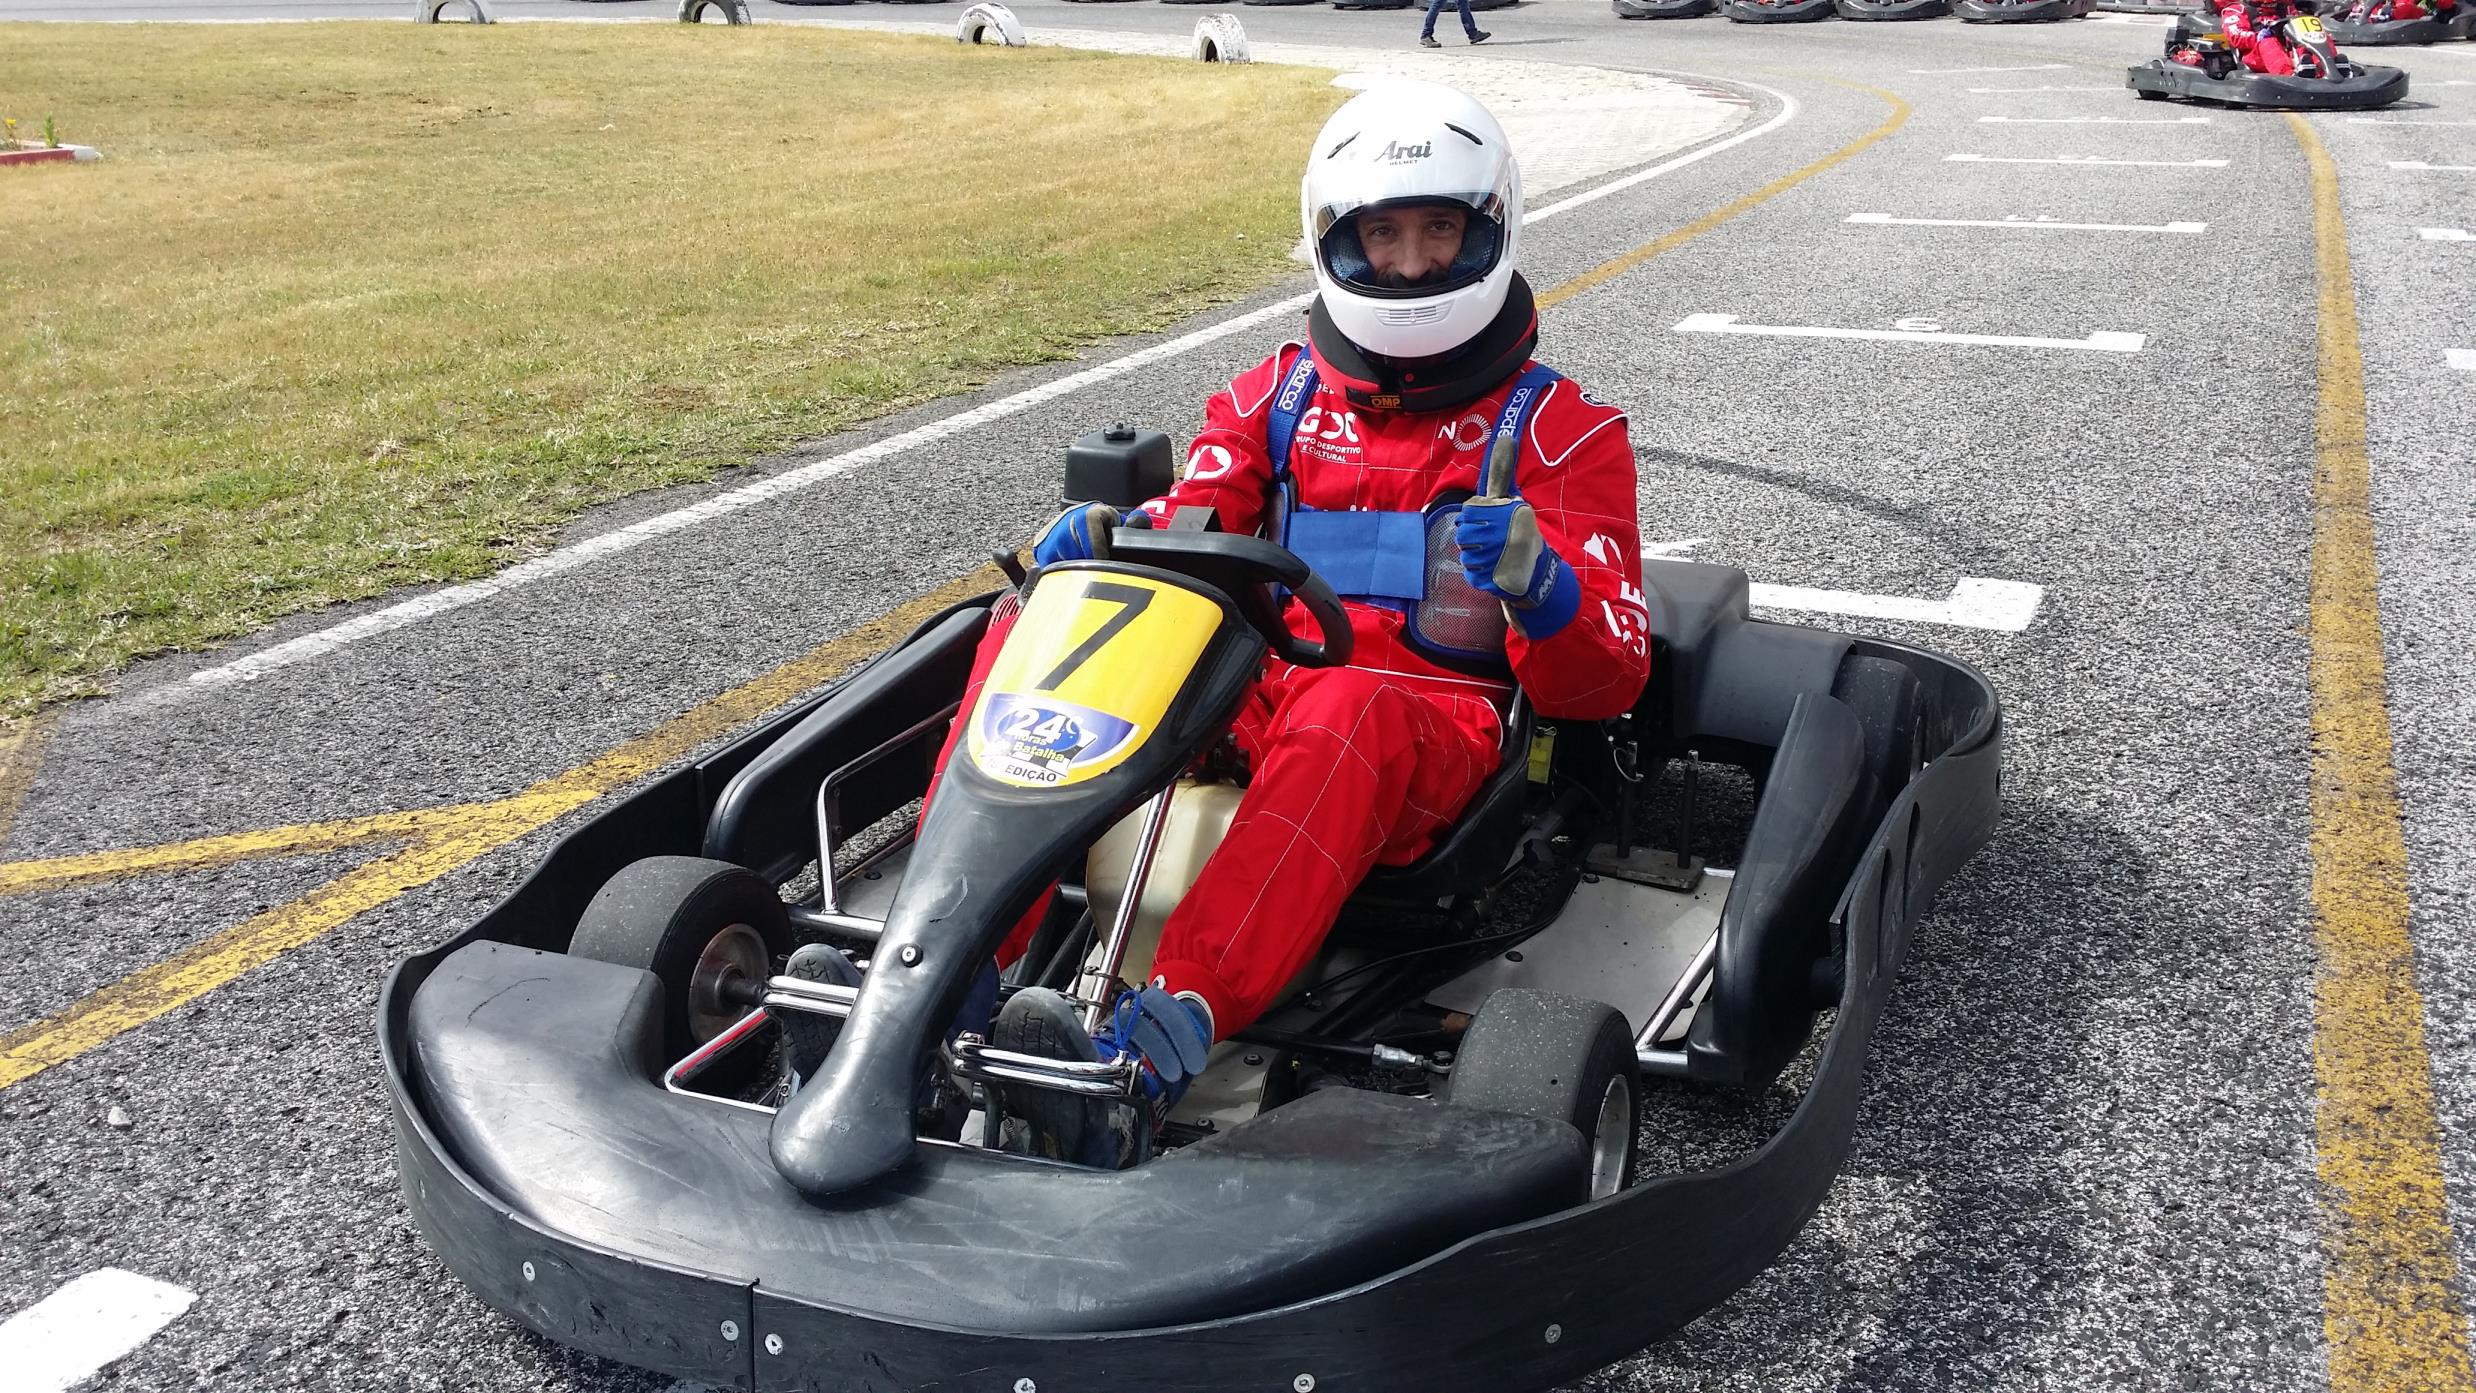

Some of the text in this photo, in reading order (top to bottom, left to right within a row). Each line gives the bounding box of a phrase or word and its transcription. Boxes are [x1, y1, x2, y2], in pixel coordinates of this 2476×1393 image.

[2302, 18, 2323, 32] 19
[1374, 140, 1434, 162] Arai
[1279, 359, 1315, 411] sparco
[1371, 396, 1401, 408] OMP
[1309, 446, 1347, 462] CULTURAL
[1317, 442, 1361, 454] DESPORTIVO
[1034, 581, 1156, 691] 7
[1004, 704, 1063, 744] 24
[1013, 741, 1066, 763] Batalha
[1004, 764, 1057, 782] EDIÇÃO
